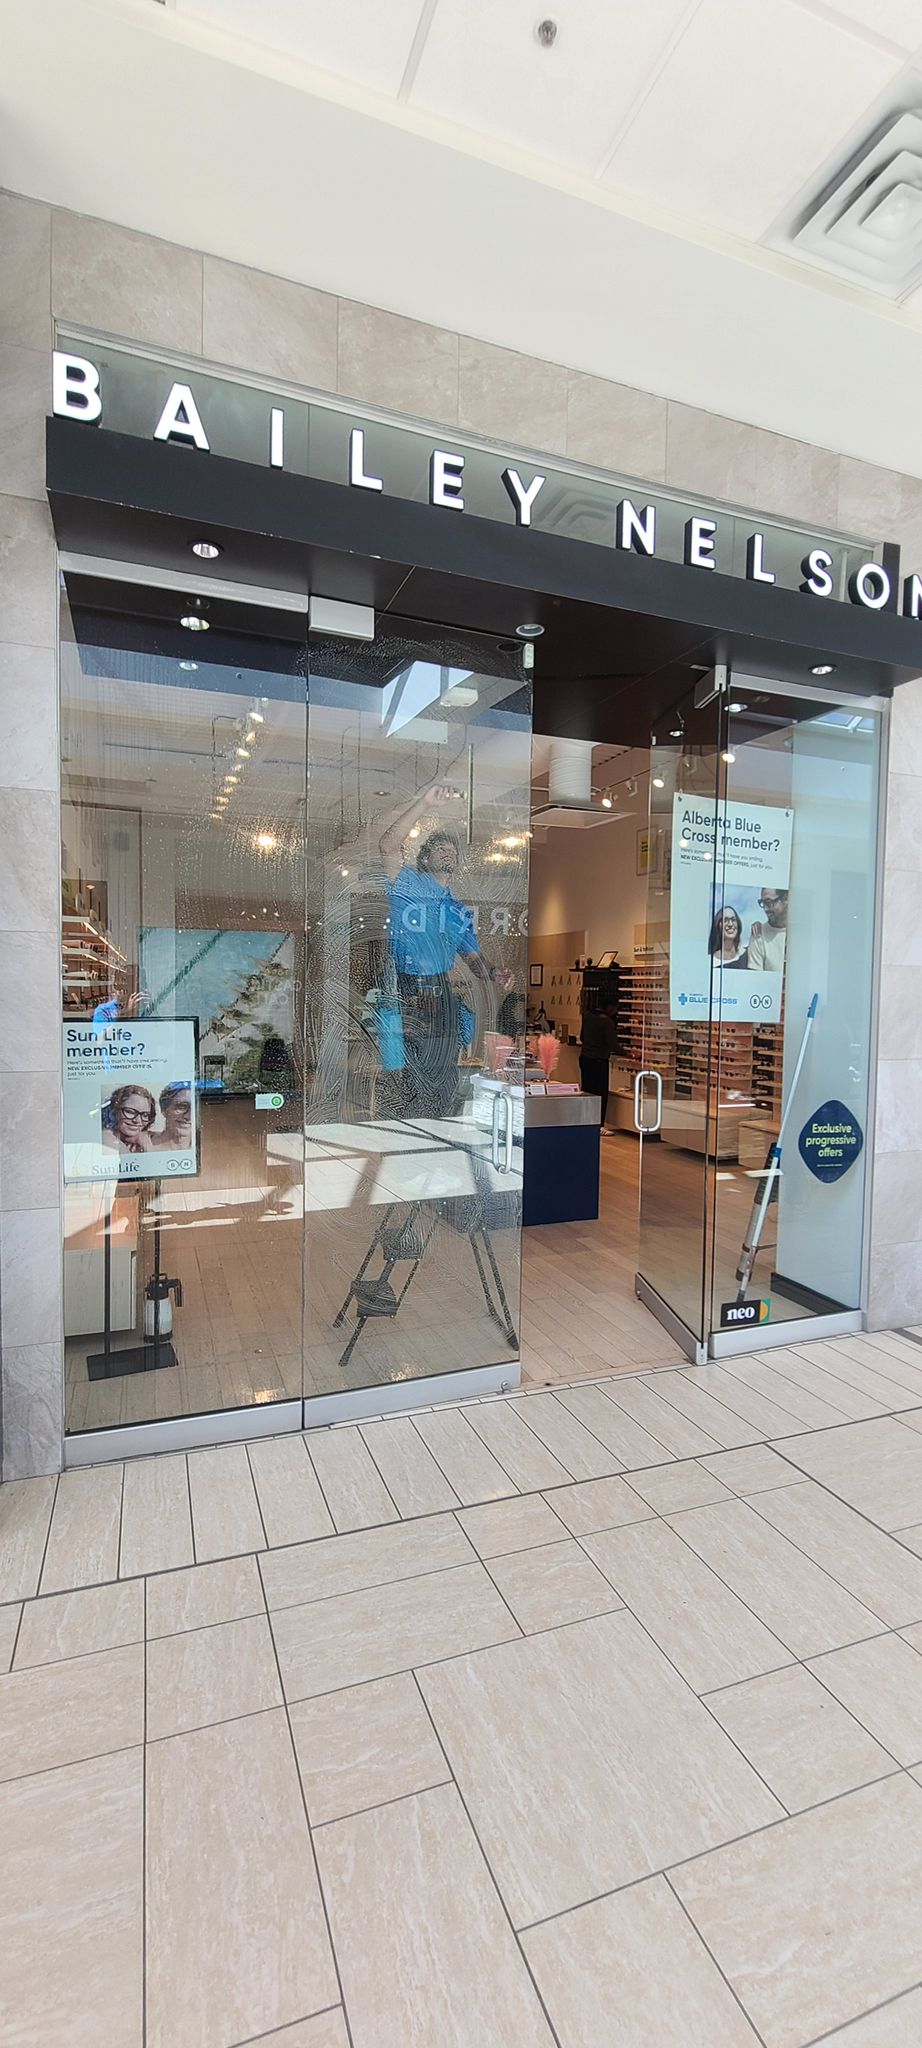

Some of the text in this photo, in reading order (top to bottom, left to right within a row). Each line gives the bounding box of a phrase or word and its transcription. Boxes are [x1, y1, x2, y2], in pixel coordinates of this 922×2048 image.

[51, 350, 545, 527] BAILEY
[682, 810, 762, 834] Alberta Blue
[681, 827, 780, 852] Cross member?
[689, 996, 708, 1004] BLUE
[67, 1028, 132, 1042] Sun Life
[67, 1043, 145, 1057] member?
[812, 1123, 852, 1133] Exclusive
[805, 1134, 857, 1148] progressive
[818, 1147, 843, 1157] offers
[92, 1161, 140, 1175] Sun Life
[726, 1306, 755, 1321] neo
